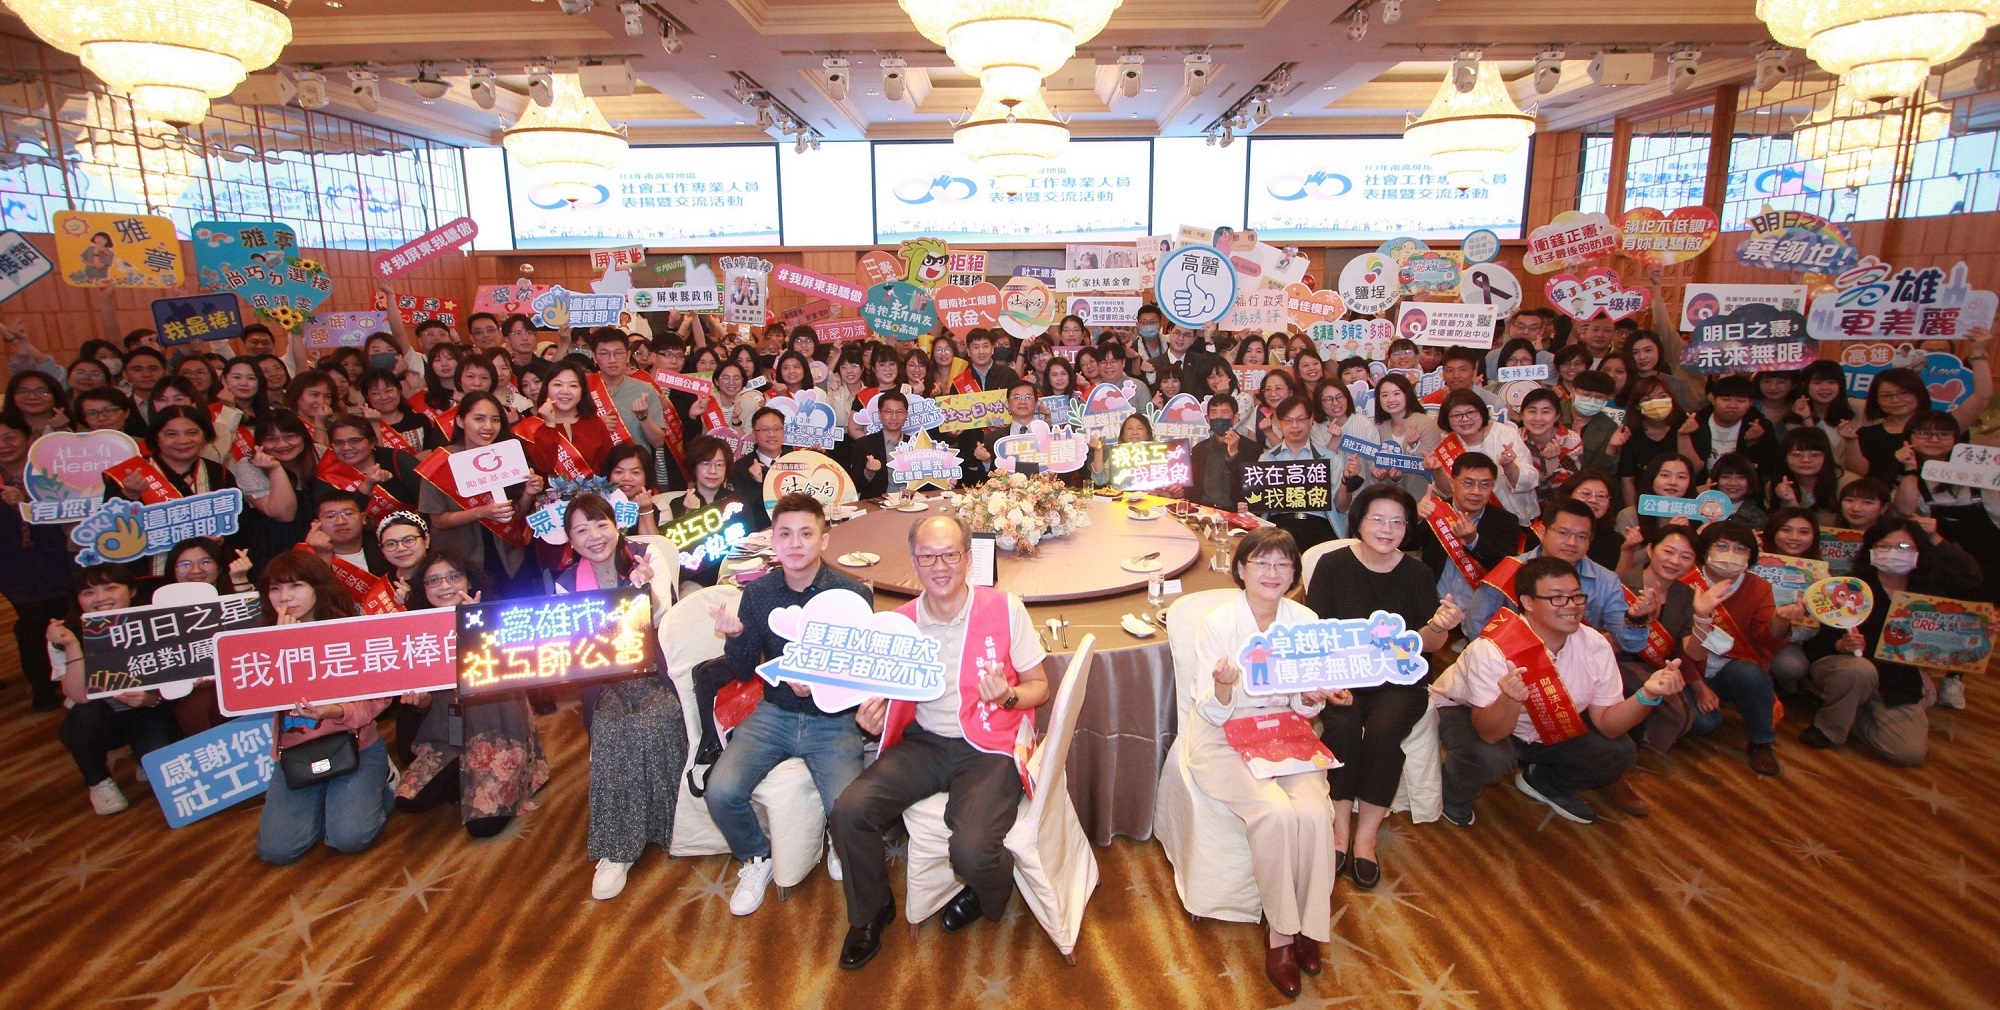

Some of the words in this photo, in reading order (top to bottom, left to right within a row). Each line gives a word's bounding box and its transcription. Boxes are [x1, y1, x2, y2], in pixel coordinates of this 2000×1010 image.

[621, 181, 759, 194] 社會工作專業人員
[621, 195, 744, 208] 表揚暨交流活動
[1751, 213, 1827, 236] 明日之星
[379, 221, 475, 277] #我屏東我驕傲
[1532, 237, 1616, 266] 孩子最後的防線
[949, 254, 986, 272] 拒絕
[1181, 253, 1221, 276] 高醫
[777, 269, 863, 304] #我屏東我驕傲
[1082, 277, 1131, 288] 家扶基金會
[1354, 285, 1386, 300] 鹽埕
[569, 298, 621, 311] 這麼厲害
[656, 290, 713, 303] 屏東縣政府
[938, 294, 997, 310] 臺南社工超棒
[1342, 290, 1400, 313] 社會福利服務中心
[163, 308, 238, 342] 我最棒!
[569, 310, 617, 323] 要確耶!
[864, 299, 933, 328] 擁抱新朋友
[1430, 319, 1473, 328] 家庭暴力及
[1841, 307, 1962, 336] 更美麗
[1429, 328, 1490, 338] 性侵害防治中心
[1702, 319, 1800, 342] 明日之憲,
[1698, 341, 1804, 368] 未來無限
[1848, 347, 1889, 364] 高雄
[1501, 368, 1548, 379] 堅持到底
[1929, 365, 1961, 377] Love
[911, 460, 943, 471] 你是光
[1243, 463, 1329, 487] 我在高雄
[1264, 486, 1329, 509] 我驕傲
[1643, 499, 1698, 516] 公會挺你
[143, 494, 236, 530] 這麼厲害
[147, 515, 232, 547] 要確耶!
[109, 597, 253, 650] 明日之星
[501, 598, 607, 645] 高雄市
[803, 621, 939, 663] 愛乘以無限大
[1271, 627, 1369, 658] 卓越社工
[783, 643, 943, 688] 大到宇宙放不下
[1274, 652, 1398, 686] 傳愛無限大
[161, 722, 274, 789] 感謝你!
